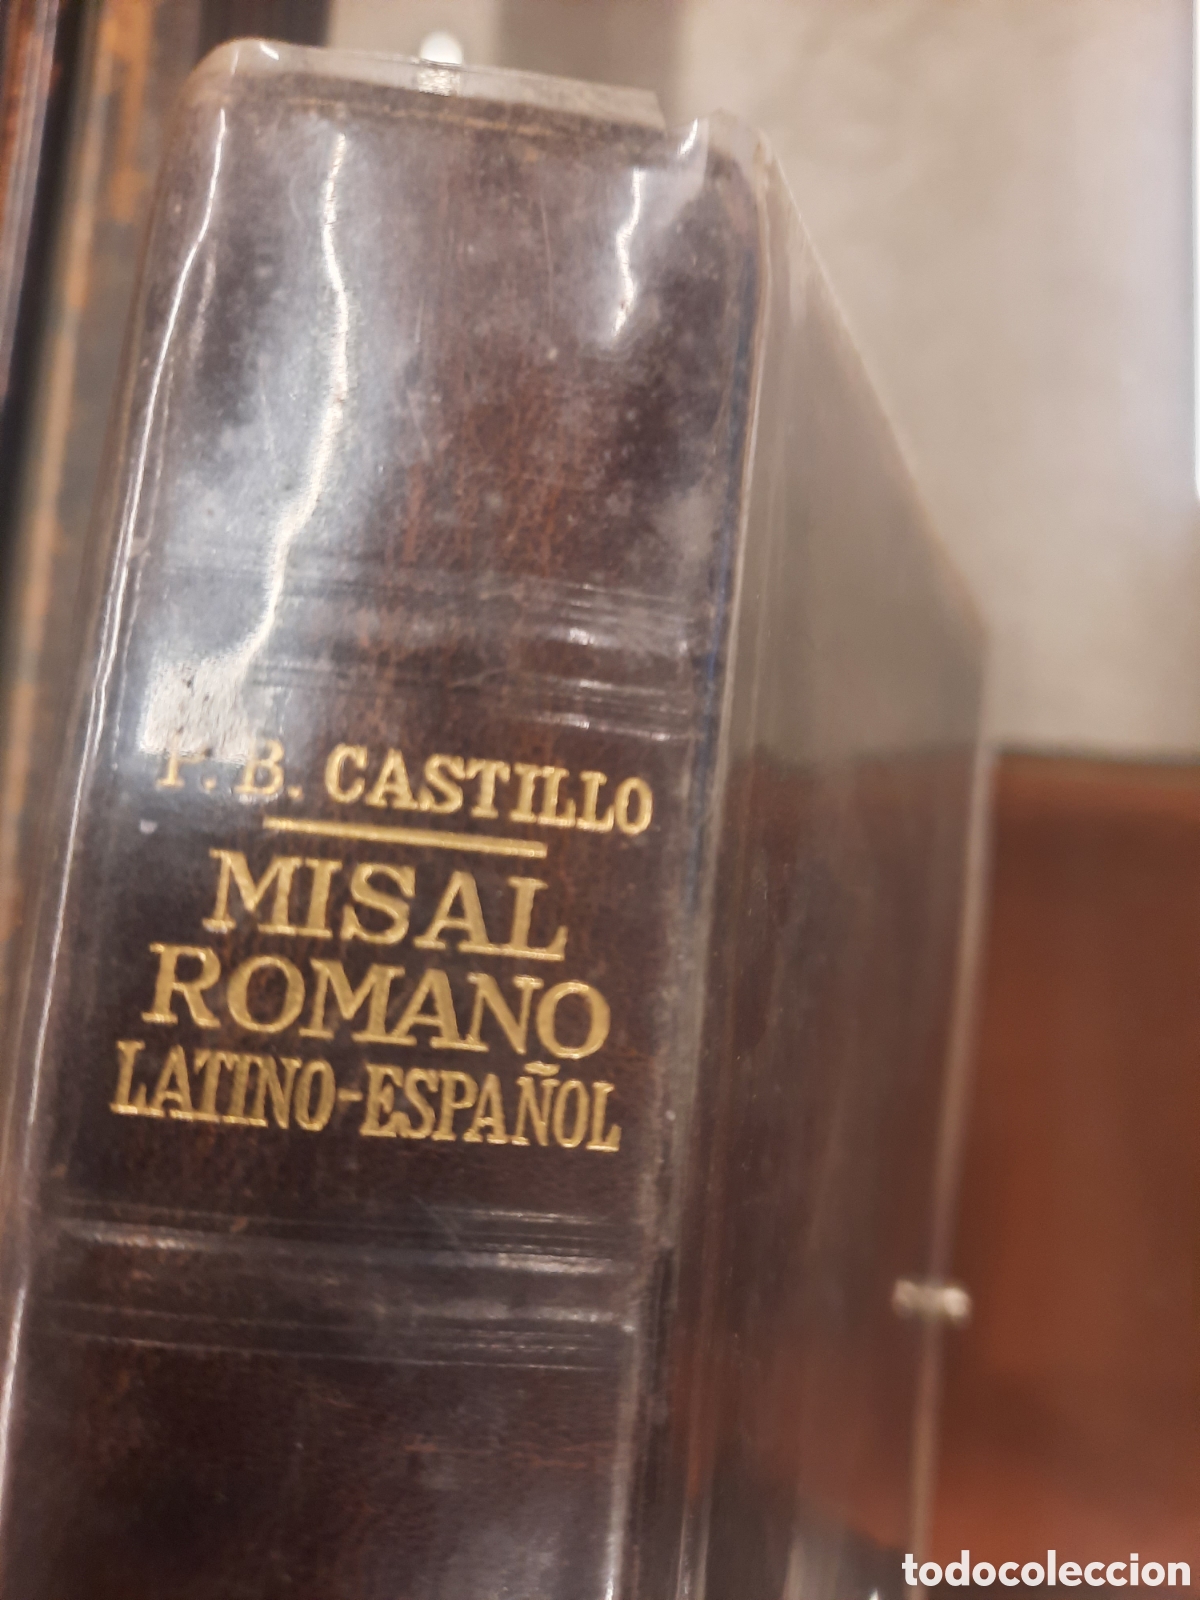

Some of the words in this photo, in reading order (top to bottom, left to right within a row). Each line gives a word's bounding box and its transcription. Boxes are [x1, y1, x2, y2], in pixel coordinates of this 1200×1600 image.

[325, 743, 653, 834] CASTILLO
[203, 849, 567, 961] MISAL
[142, 943, 611, 1060] ROMANO
[110, 1040, 621, 1152] LATINO-ESPAÑOL
